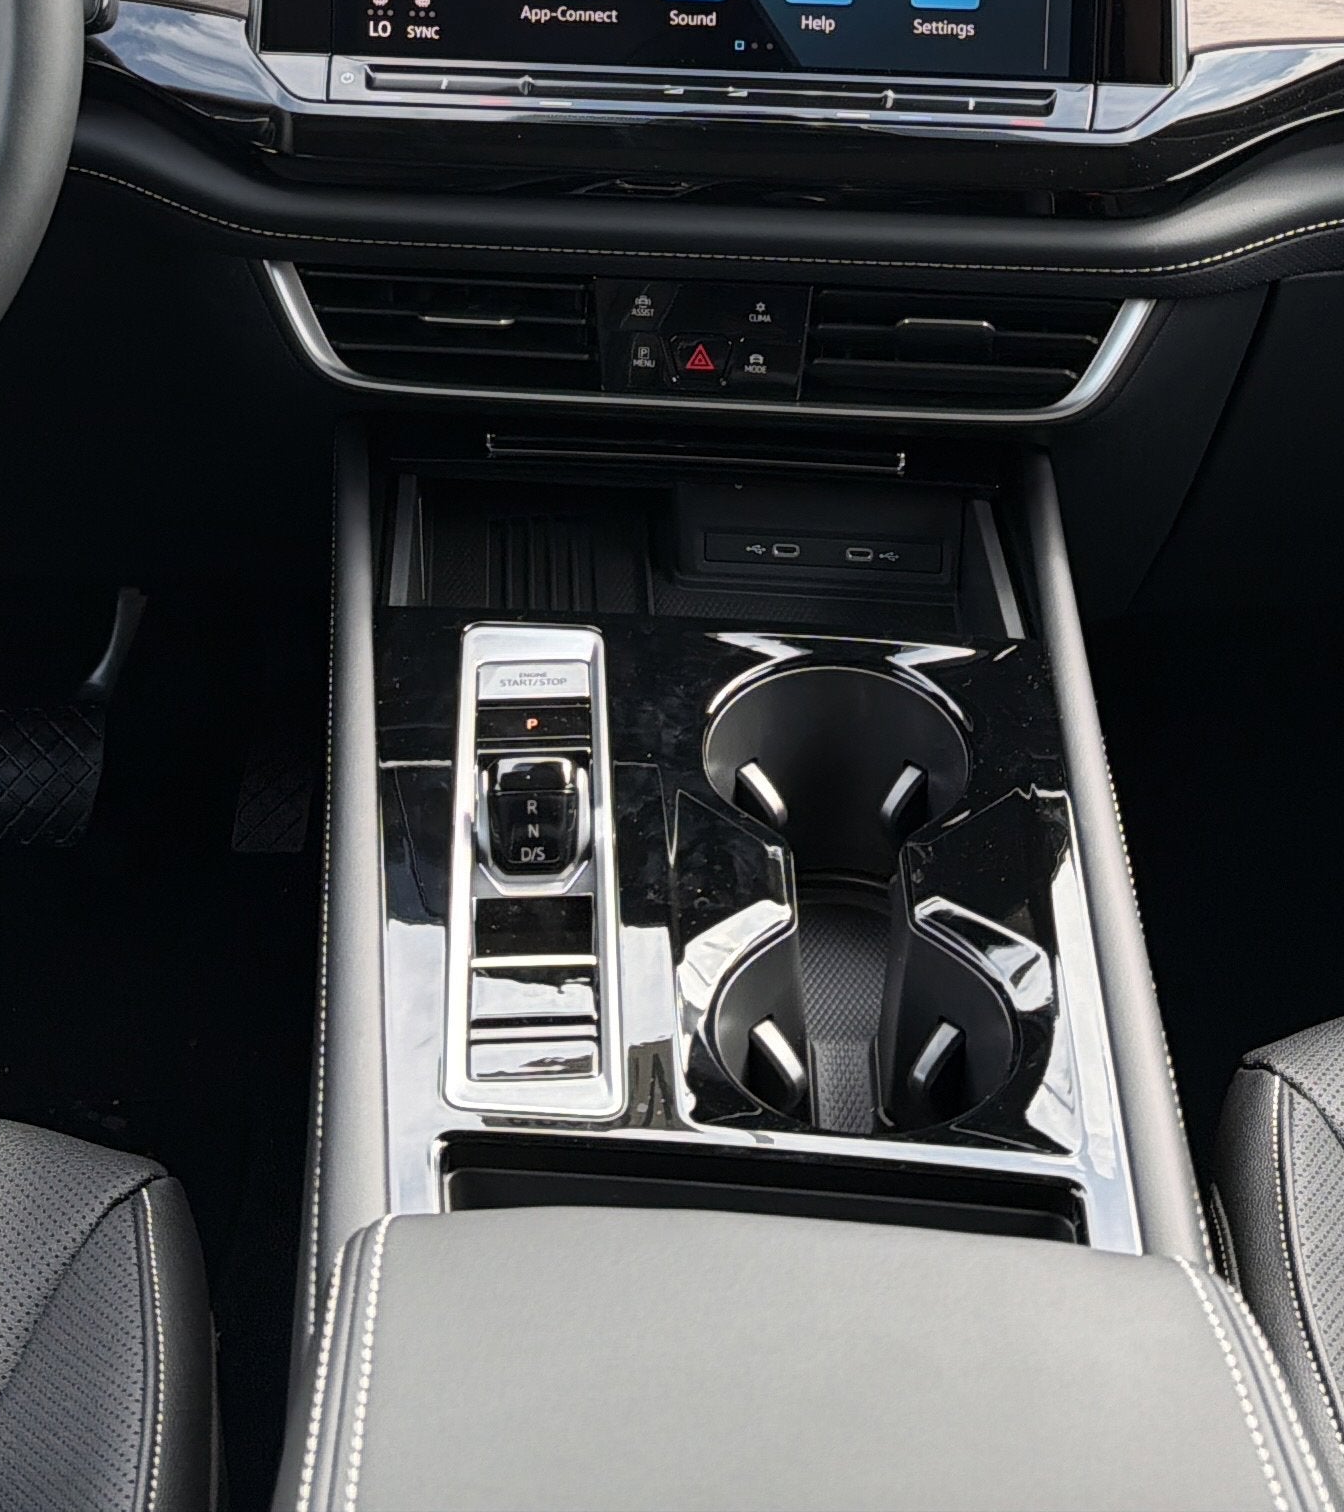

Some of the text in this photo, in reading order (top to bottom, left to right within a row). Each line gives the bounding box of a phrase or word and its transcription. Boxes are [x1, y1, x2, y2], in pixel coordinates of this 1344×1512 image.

[520, 6, 618, 25] App-Connect
[669, 10, 717, 27] Sound
[368, 20, 392, 38] LO
[800, 14, 836, 35] Help
[913, 19, 975, 39] Settings
[406, 25, 441, 40] SYNC
[630, 308, 655, 317] ASSIST
[748, 313, 772, 323] CLIMA
[632, 358, 656, 369] MENU
[744, 365, 768, 375] MODE
[499, 676, 568, 689] START/STOP
[518, 671, 548, 679] ENGINE
[527, 718, 539, 730] P
[527, 799, 538, 815] R
[528, 823, 540, 839] N
[520, 846, 546, 863] D/S
